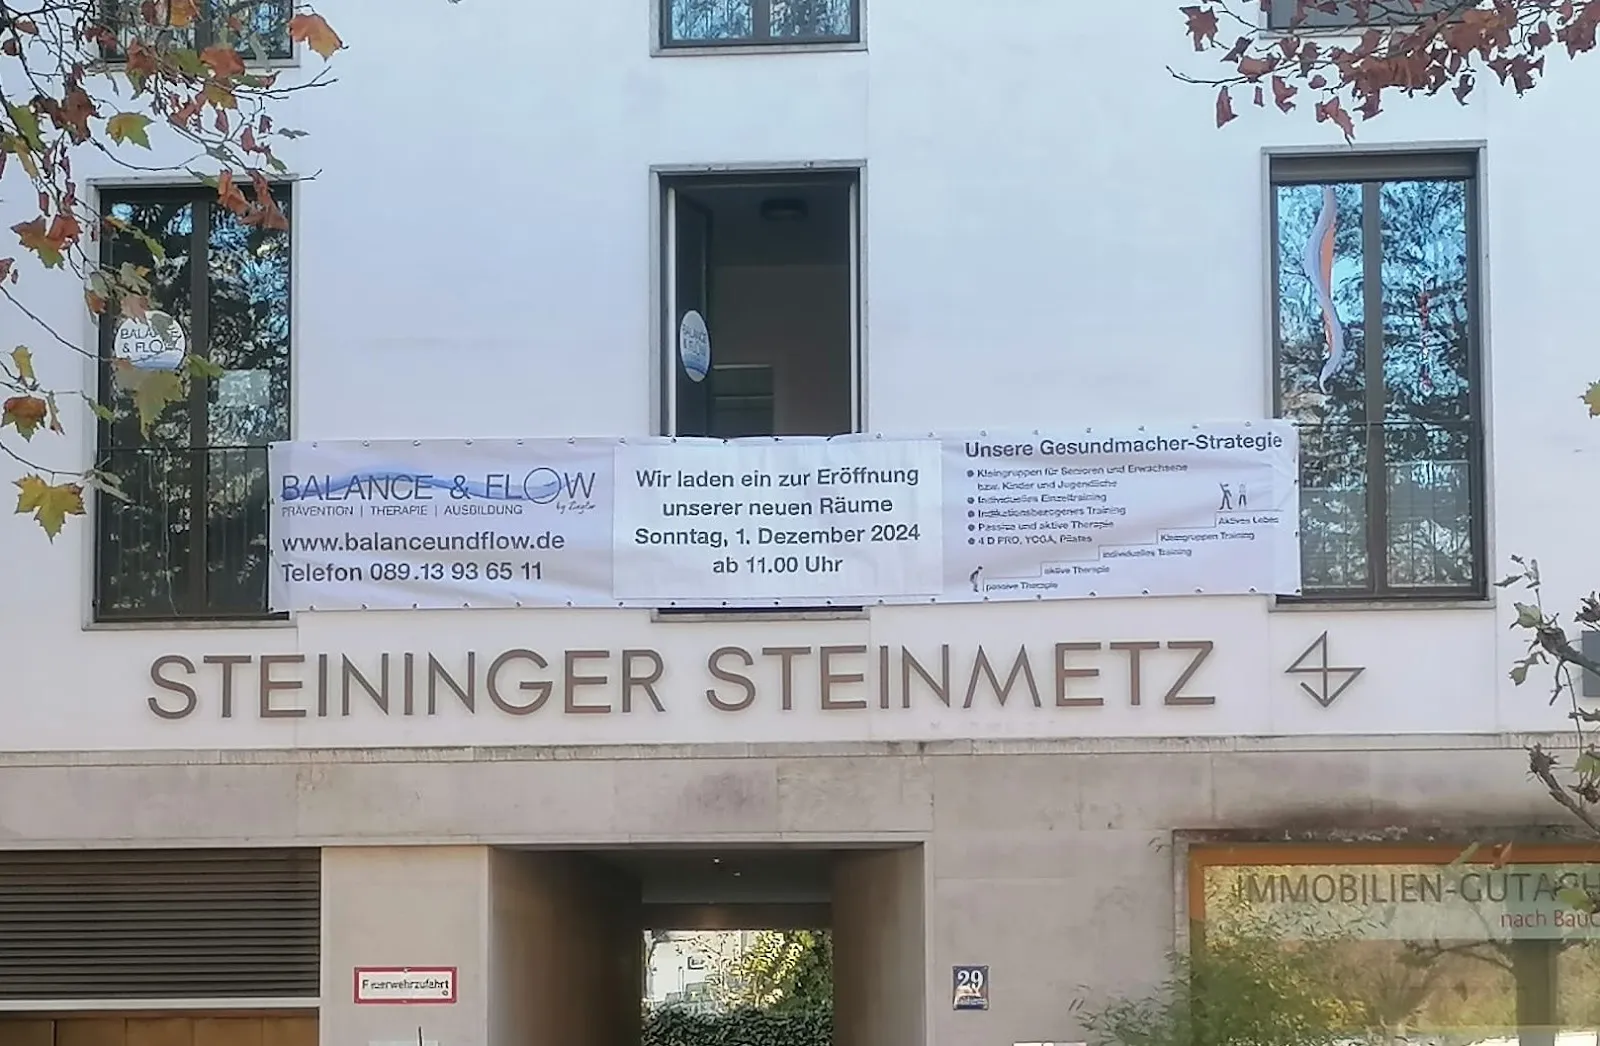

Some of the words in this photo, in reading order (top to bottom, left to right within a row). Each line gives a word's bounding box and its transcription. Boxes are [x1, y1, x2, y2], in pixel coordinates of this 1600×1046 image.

[123, 343, 130, 353] &
[965, 441, 1034, 458] Unsere
[1040, 432, 1282, 455] Gesundmacher-Strategie
[282, 474, 434, 501] BALANCE
[450, 475, 471, 500] &
[486, 467, 596, 504] FLOW
[636, 470, 671, 488] Wir
[677, 470, 735, 488] laden
[741, 470, 772, 487] ein
[779, 471, 810, 487] zur
[817, 467, 919, 486] Eröffnung
[370, 505, 428, 516] THERAPIE
[444, 504, 523, 515] AUSBILDUNG
[663, 502, 742, 516] unserer
[749, 500, 812, 516] neuen
[820, 497, 893, 514] Räume
[282, 531, 565, 552] www.balanceundflow.de
[635, 527, 729, 548] Sonntag,
[735, 528, 751, 545] 1.
[758, 526, 865, 545] Dezember
[871, 523, 921, 542] 2024
[282, 563, 362, 583] Telefon
[451, 562, 479, 580] 93
[486, 562, 512, 580] 65
[520, 561, 542, 579] 11
[713, 556, 739, 574] ab
[746, 556, 799, 574] 11.00
[806, 556, 843, 573] Uhr
[147, 648, 666, 720] STEININGER
[705, 640, 1217, 712] STEINMETZ
[1501, 909, 1547, 928] nach
